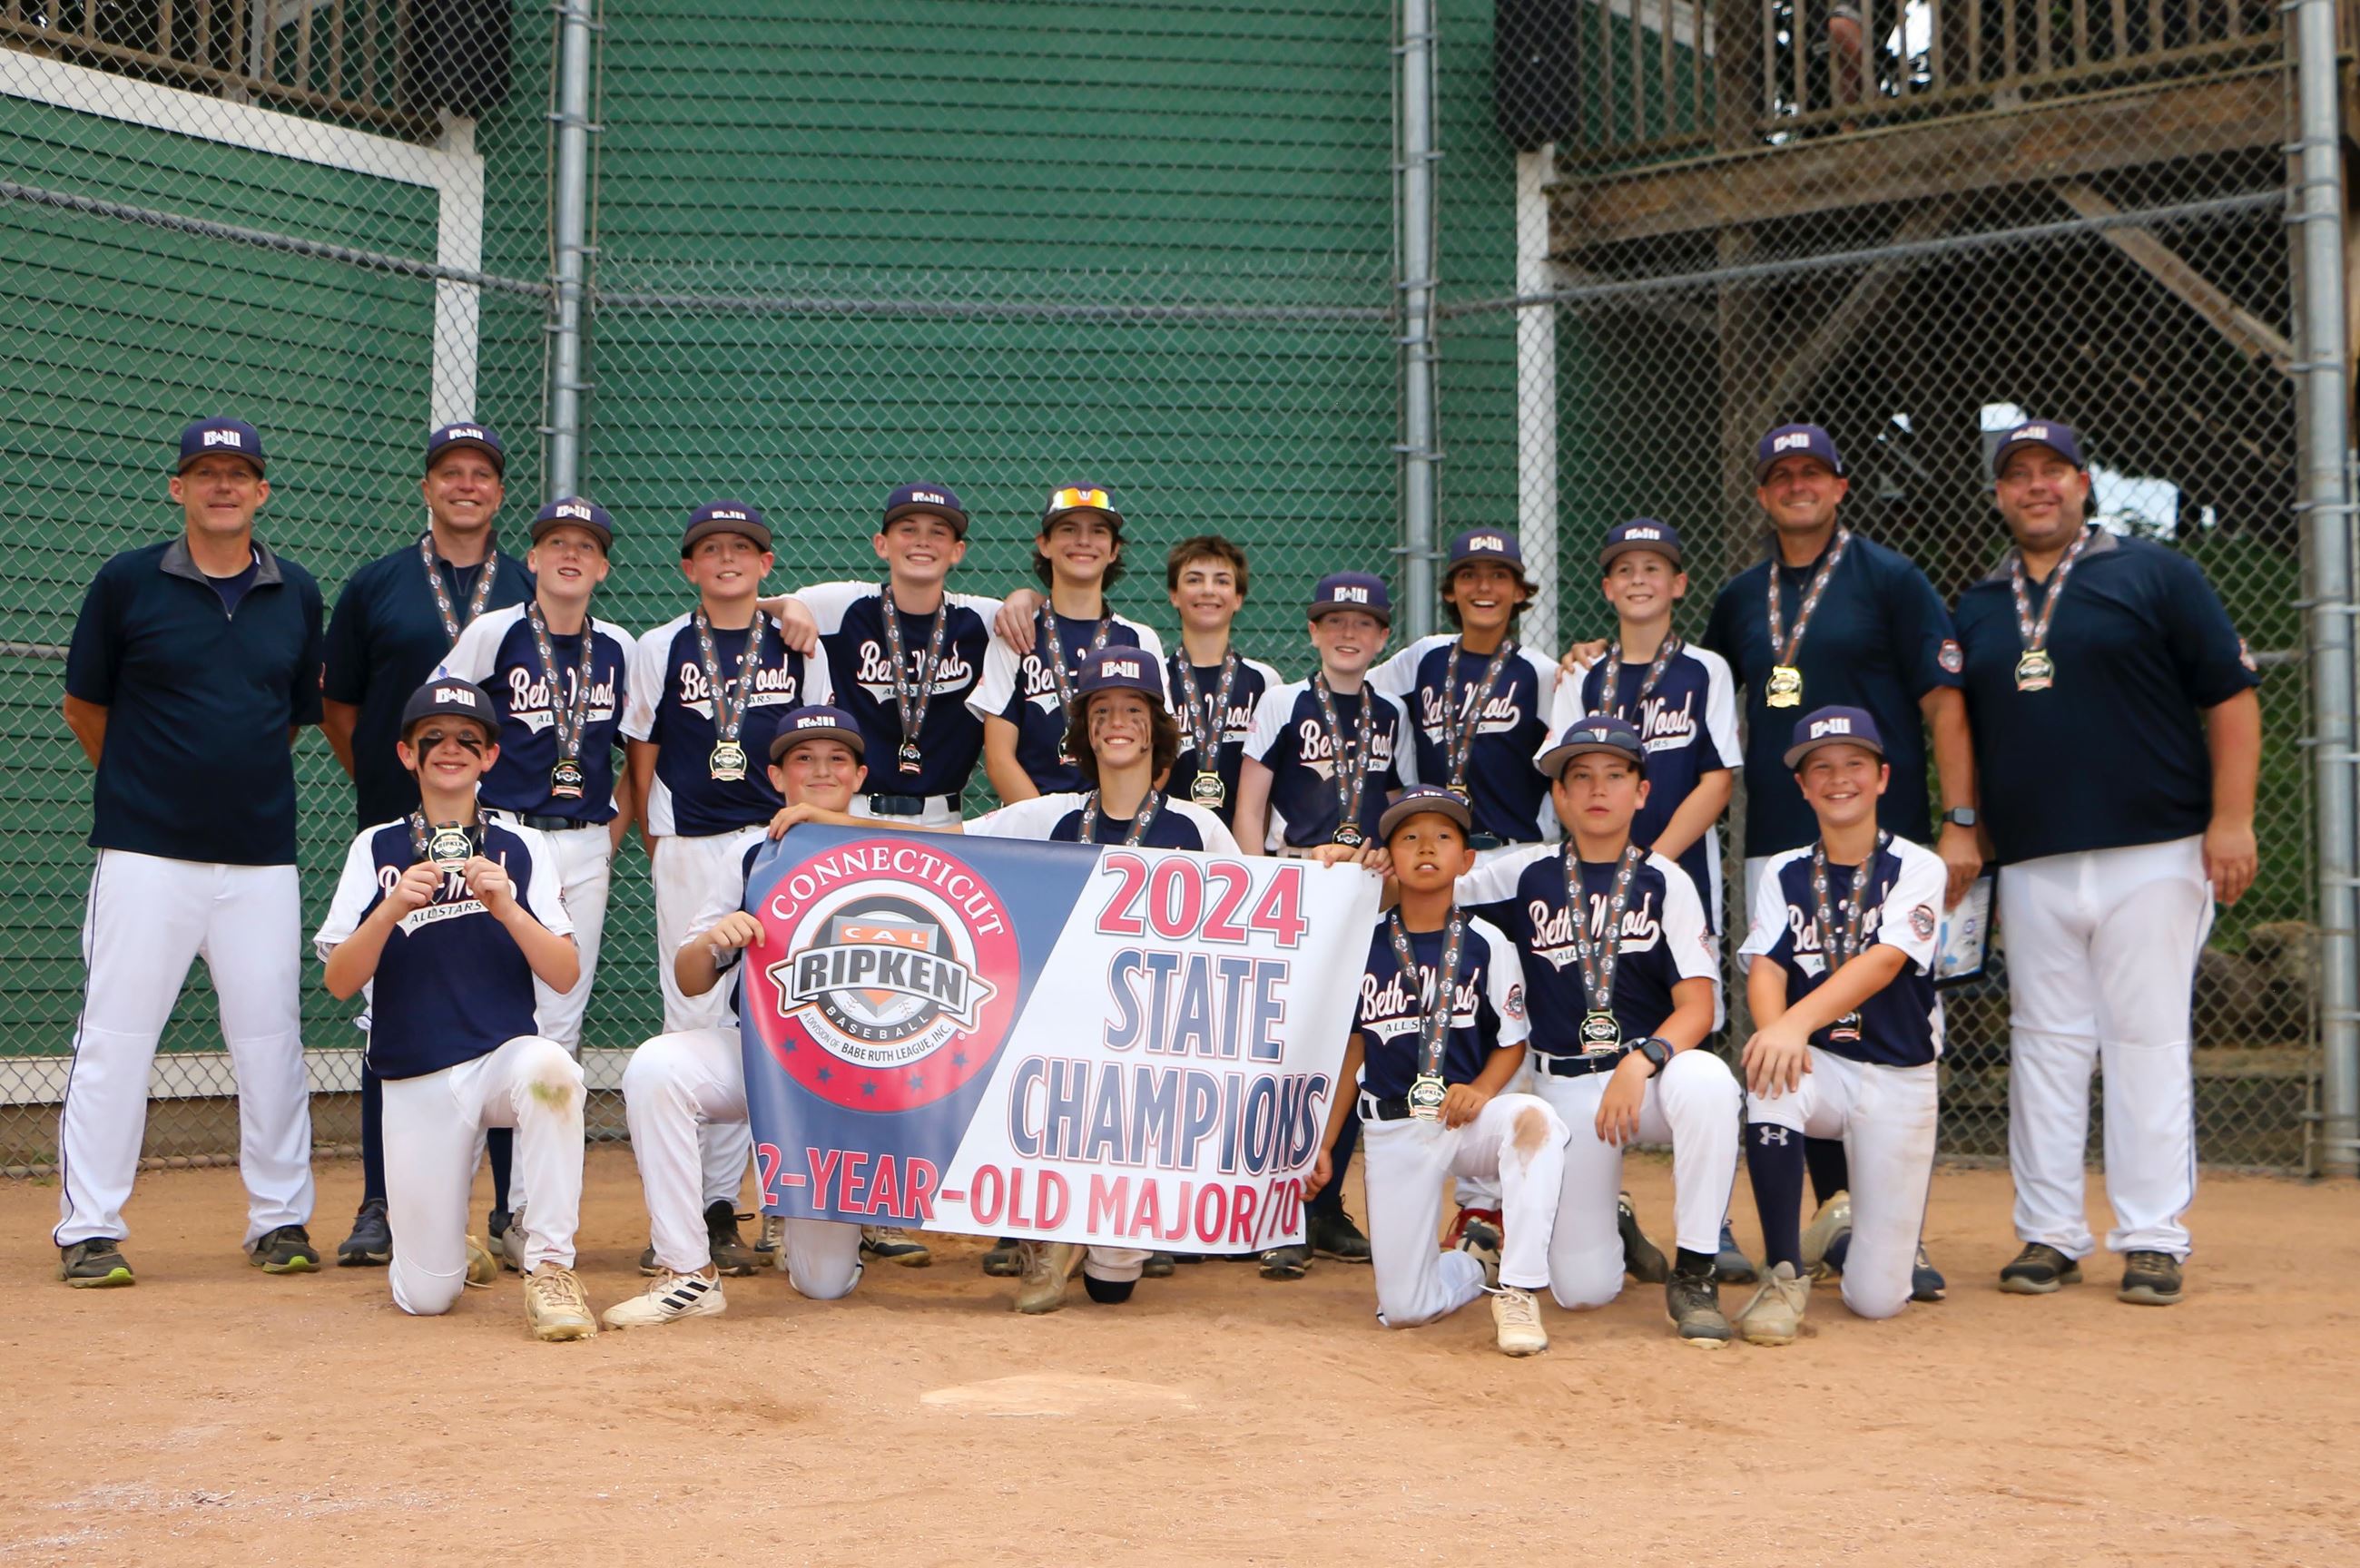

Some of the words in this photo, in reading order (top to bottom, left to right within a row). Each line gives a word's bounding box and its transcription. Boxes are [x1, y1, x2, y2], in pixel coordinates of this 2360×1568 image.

[772, 847, 1004, 936] CONNECTICUT
[1096, 851, 1310, 950] 2024
[844, 927, 925, 945] CAL
[799, 948, 961, 1006] RIPKEN
[1104, 946, 1290, 1063] STATE
[806, 1015, 831, 1044] DIVISION
[830, 1039, 841, 1048] OF
[841, 1043, 866, 1060] BABE
[869, 1051, 893, 1062] RUTH
[897, 1039, 934, 1060] LEAGUE,
[933, 1024, 951, 1042] INC.
[826, 1006, 929, 1040] BASEBALL
[1008, 1054, 1331, 1177] CHAMPIONS
[1087, 1173, 1303, 1250] MAJOR/70
